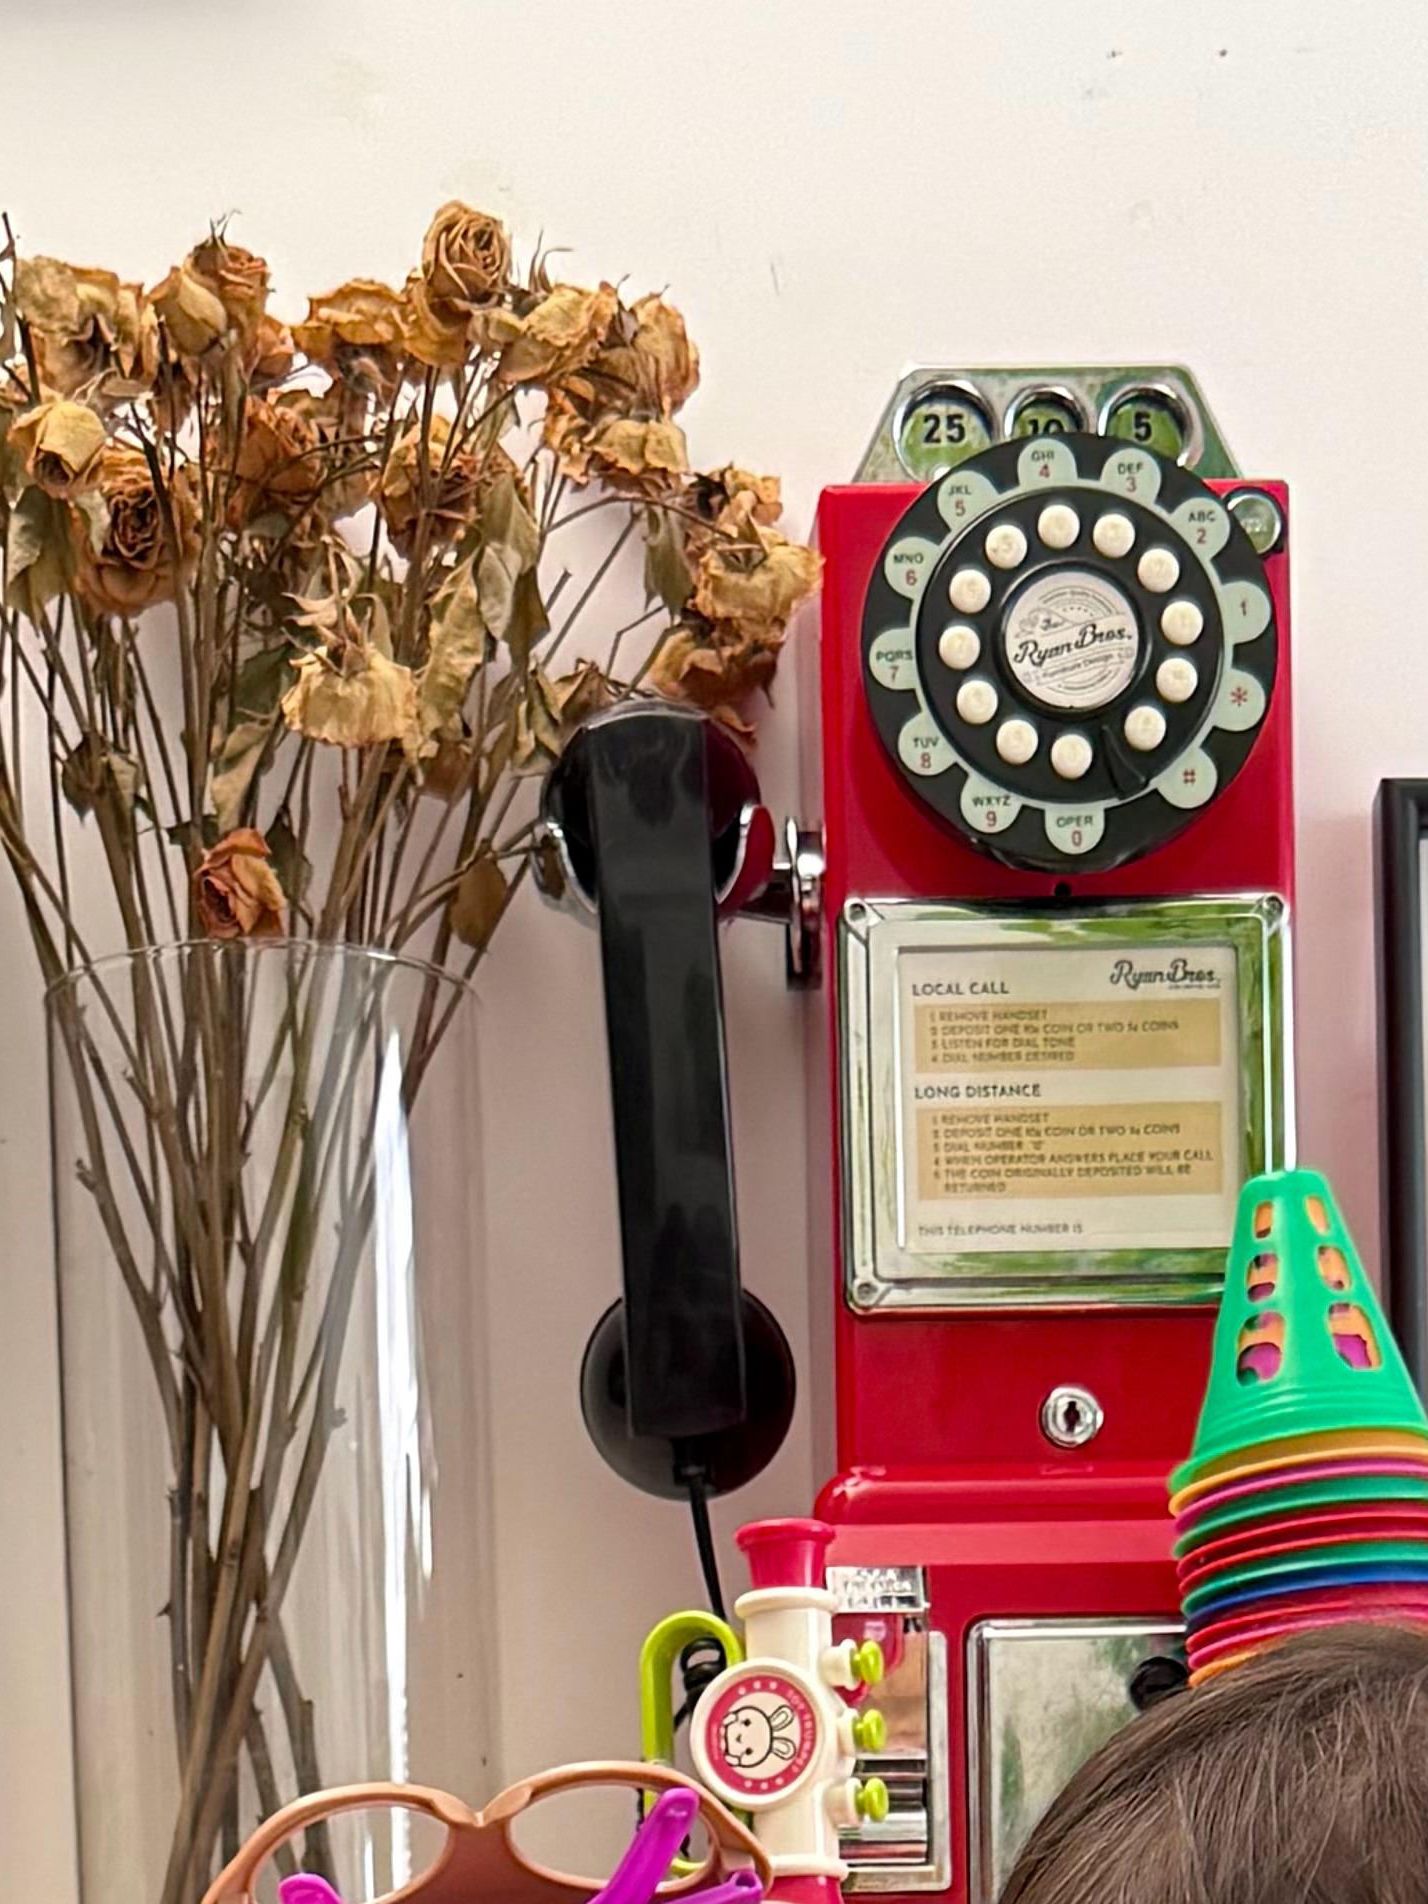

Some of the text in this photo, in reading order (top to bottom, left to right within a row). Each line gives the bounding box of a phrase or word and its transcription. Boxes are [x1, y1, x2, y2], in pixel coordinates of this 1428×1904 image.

[922, 414, 966, 444] 25
[1134, 413, 1152, 441] 5
[1031, 450, 1054, 462] GHI
[1039, 464, 1050, 479] 4
[1117, 462, 1143, 475] DEF
[947, 484, 972, 496] JKL
[1126, 477, 1137, 492] 3
[955, 500, 966, 516] 5
[1188, 510, 1215, 523] ABC
[1196, 528, 1207, 544] 2
[894, 553, 923, 565] MNO
[906, 570, 917, 586] 6
[1013, 623, 1132, 667] Ryan Bros.
[889, 666, 899, 683] 7
[913, 736, 938, 749] TUV
[921, 753, 931, 768] 8
[972, 795, 1011, 807] WXYZ
[986, 811, 996, 827] 9
[1057, 815, 1093, 827] OPER
[1072, 831, 1082, 846] 0
[1110, 960, 1165, 990] Ryan
[912, 981, 1009, 996] LOCAL CALL
[915, 1084, 1041, 1099] LONG DISTANCE
